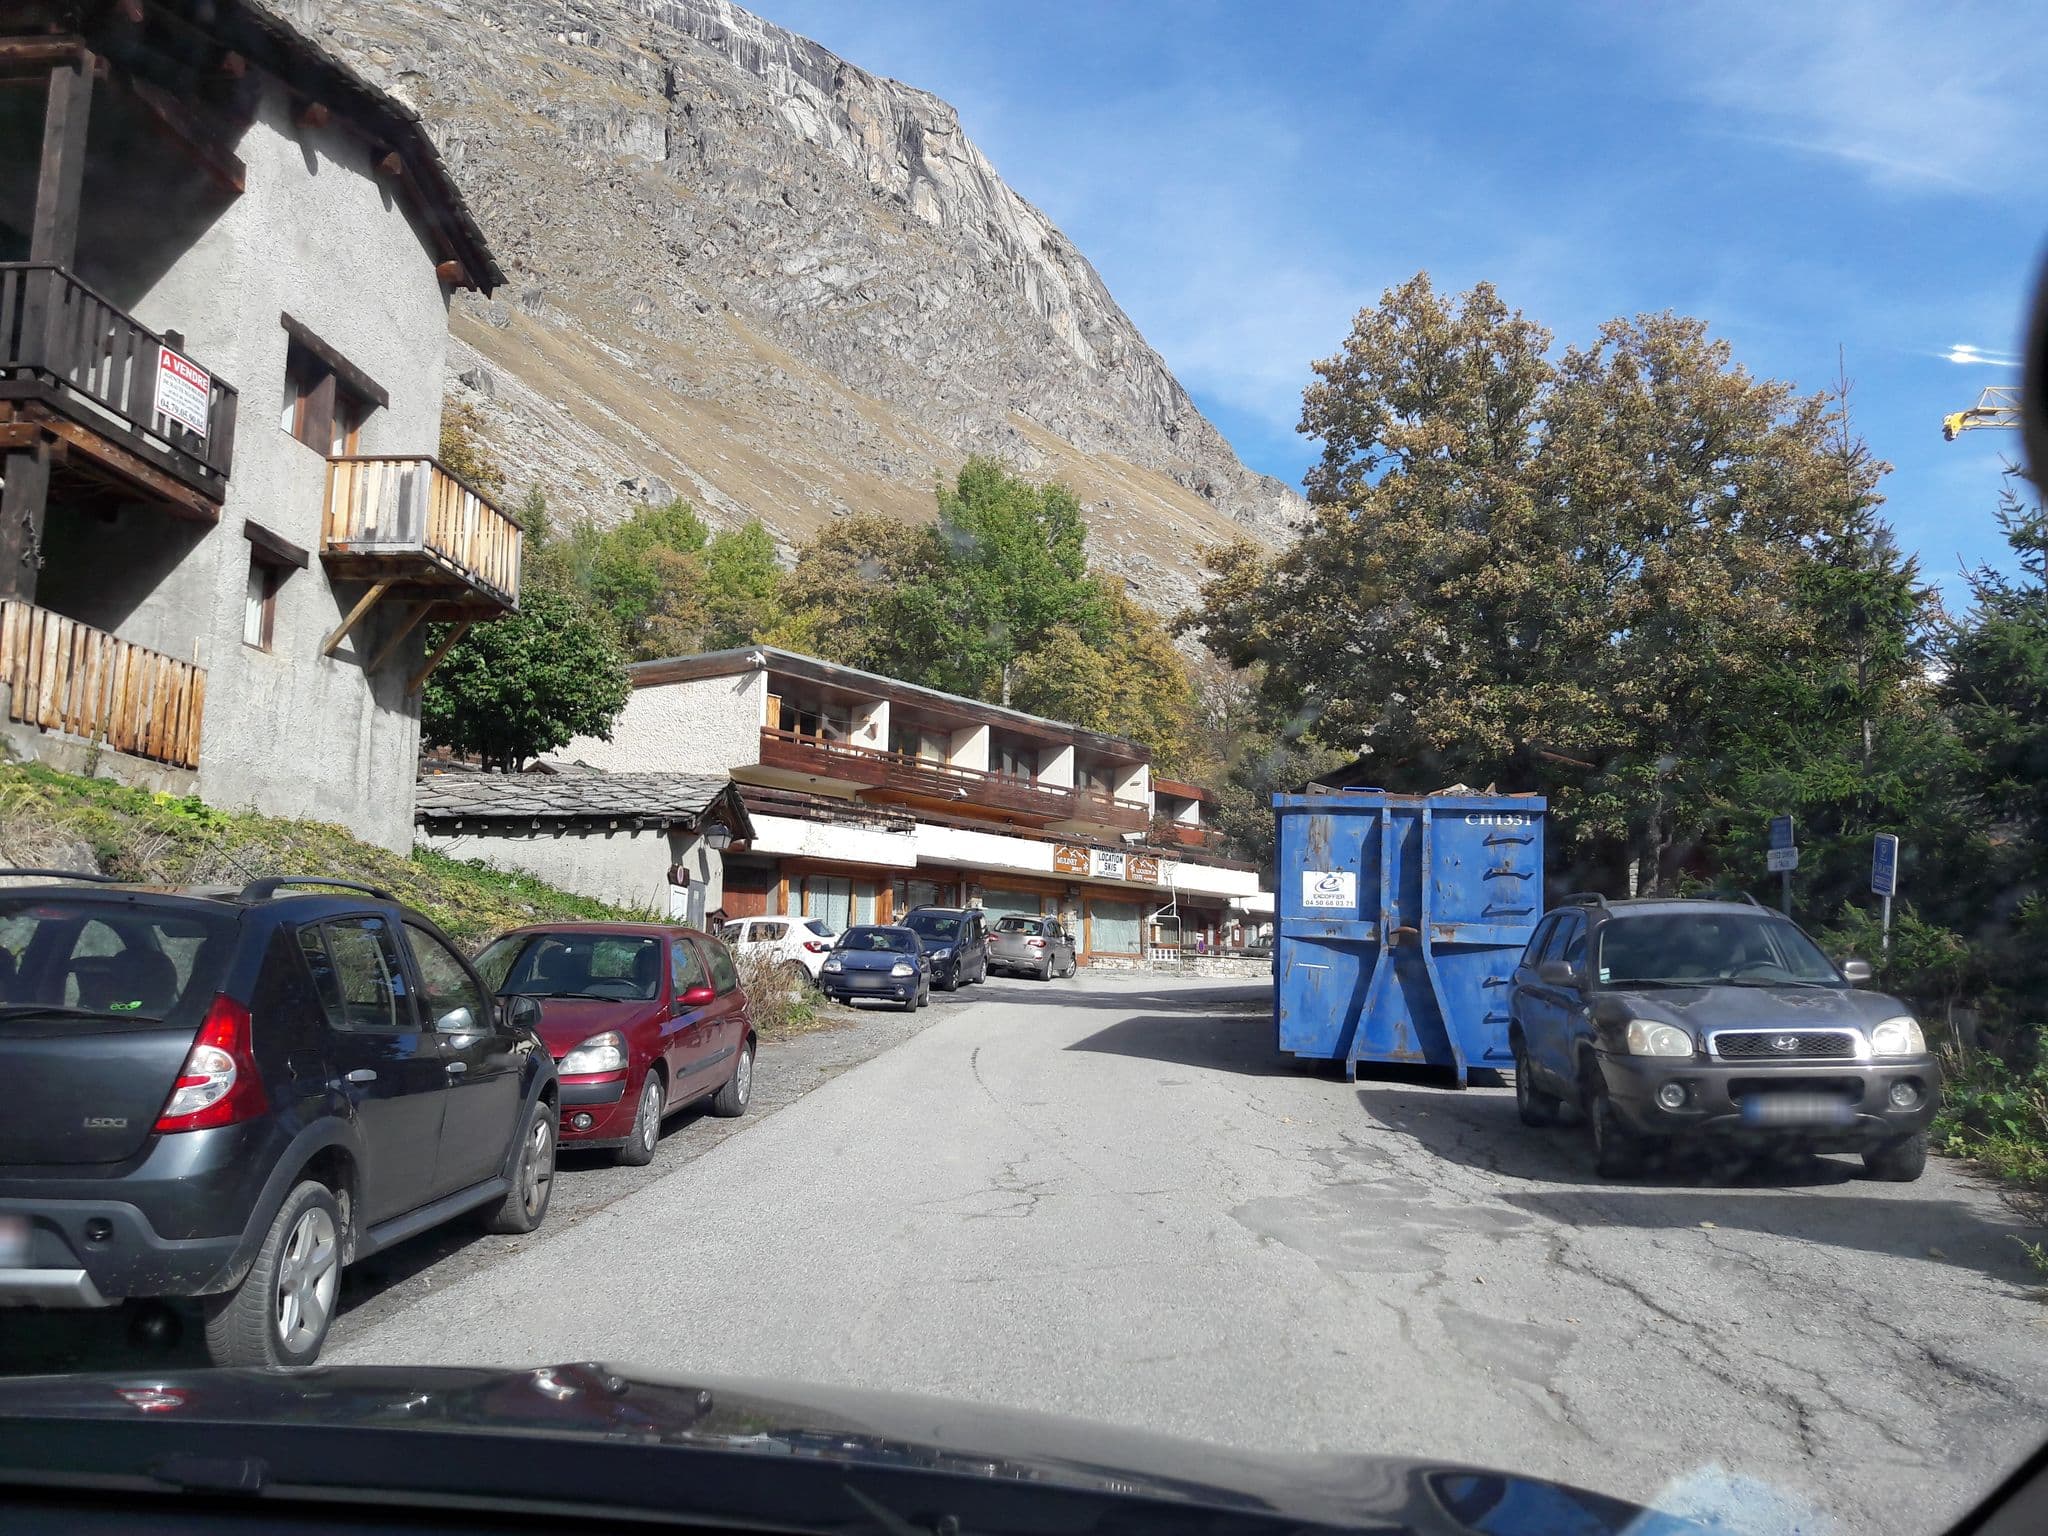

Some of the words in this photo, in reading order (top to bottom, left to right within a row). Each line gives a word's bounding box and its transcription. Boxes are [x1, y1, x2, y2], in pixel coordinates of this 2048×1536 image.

[163, 354, 171, 367] A
[173, 358, 208, 389] VENDRE
[1464, 813, 1532, 826] CH1331
[1098, 852, 1123, 864] LOCATION
[1104, 862, 1117, 872] SKIS
